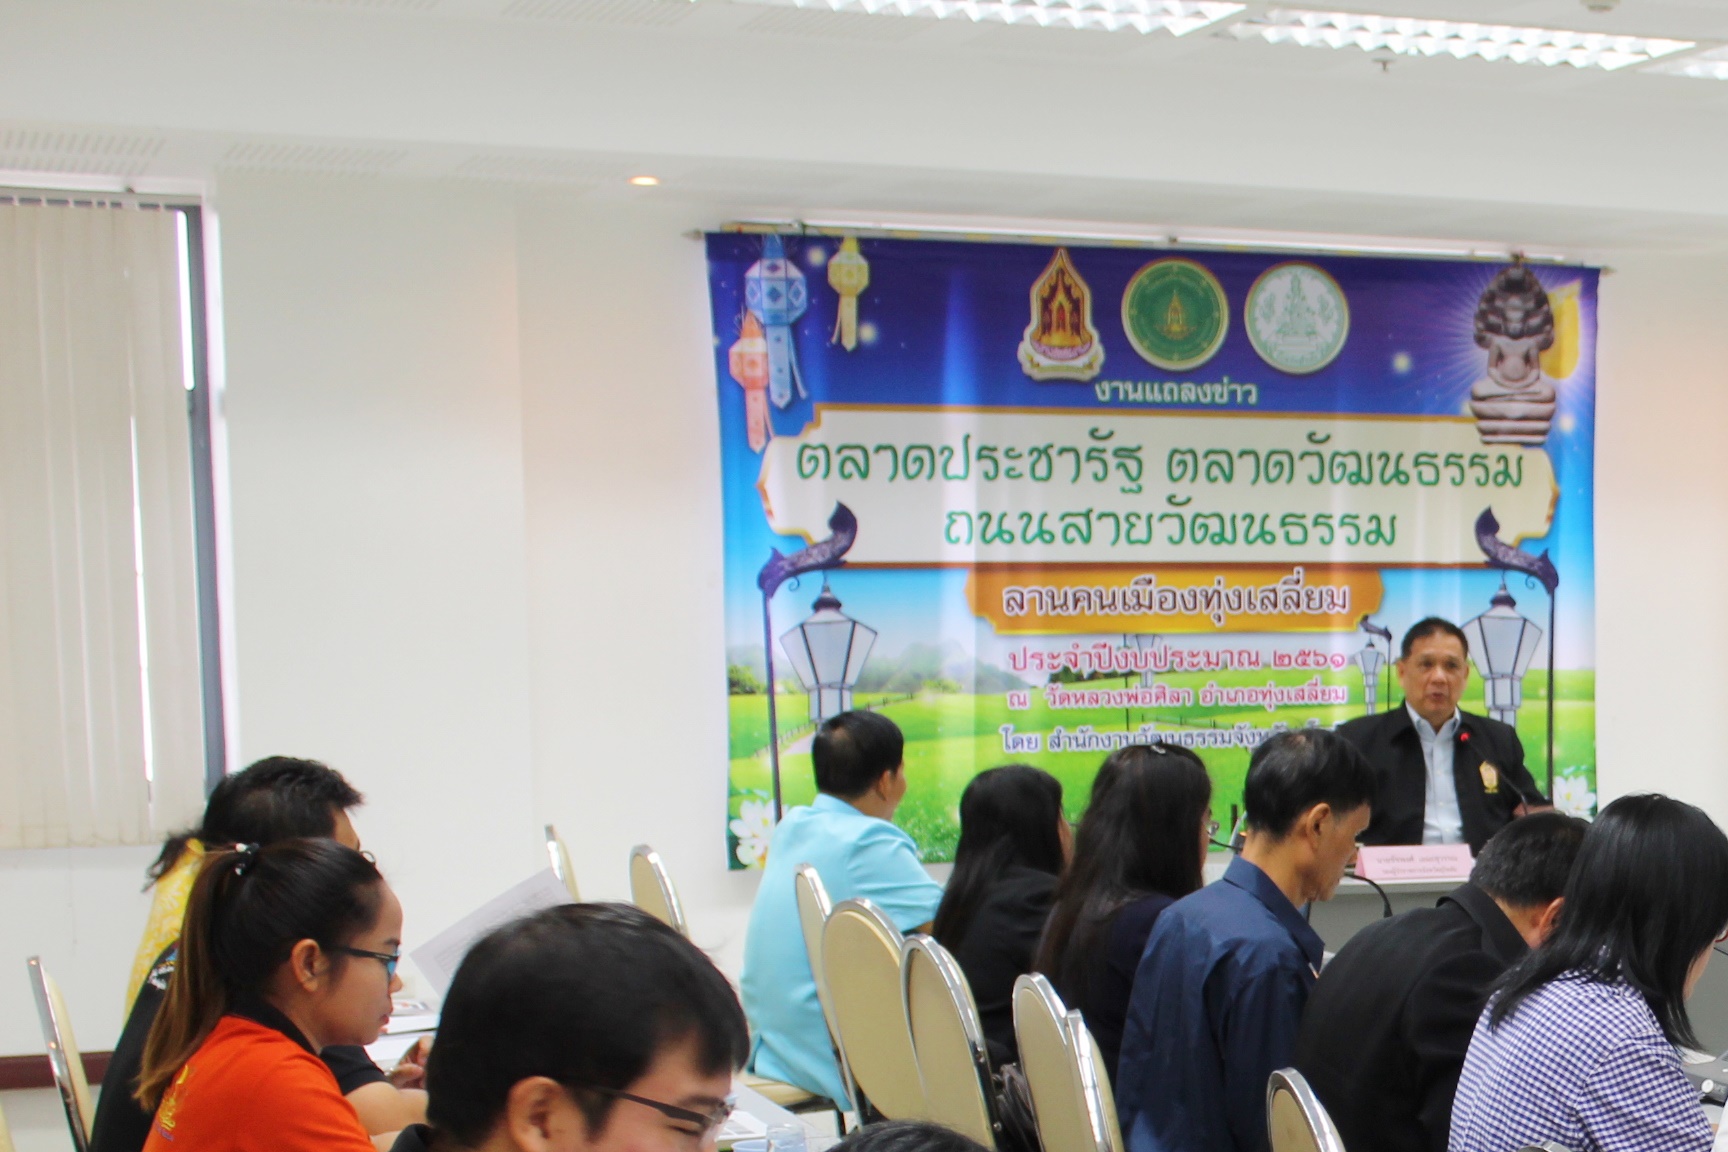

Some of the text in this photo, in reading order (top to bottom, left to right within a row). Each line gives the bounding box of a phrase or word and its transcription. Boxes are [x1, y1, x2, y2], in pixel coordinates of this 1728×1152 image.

[1095, 377, 1258, 405] งานแถลงข่าว
[796, 427, 1523, 493] ตลาดประชารัฐ ตลาดวัฒนธรรม
[945, 494, 1397, 546] ถนนสายวัฒนธรรม
[1004, 570, 1347, 623] ลานคนเมืองทุ่งเสลี่ยม
[1009, 642, 1345, 671] ประจำปีงบประมาณ ๒๕๖๑
[1008, 677, 1346, 710] ณ วัดหลวงพ่อศิลา อำเภอทุ่งเสลี่ยม
[1001, 726, 1039, 750] โดย
